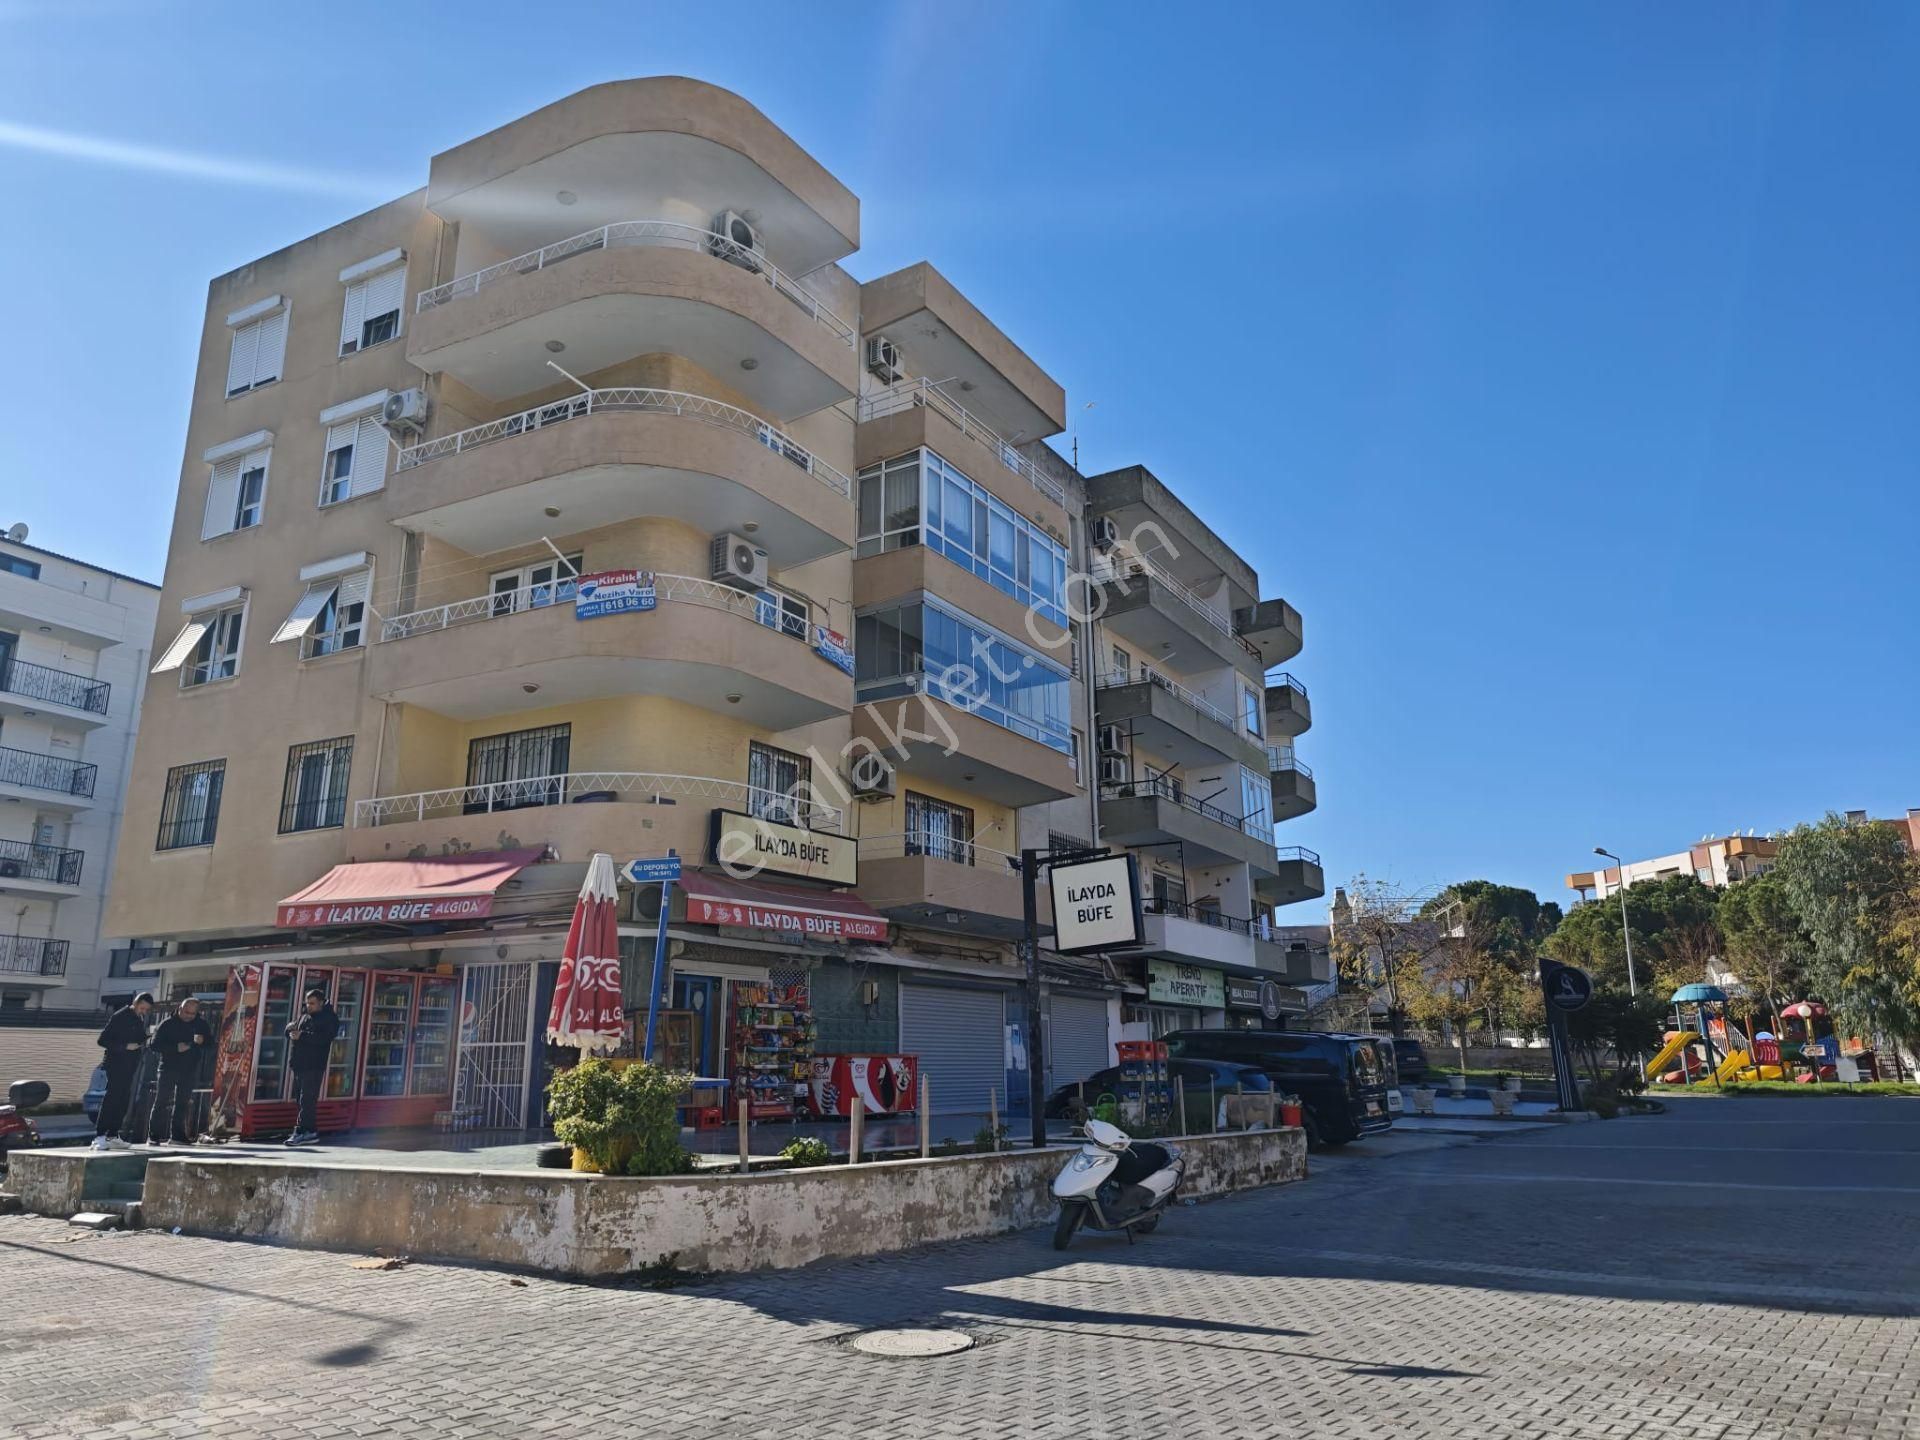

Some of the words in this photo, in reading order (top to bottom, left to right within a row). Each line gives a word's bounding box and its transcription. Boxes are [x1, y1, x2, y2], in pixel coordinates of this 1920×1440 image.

[598, 573, 636, 585] Kiralık
[605, 599, 625, 610] 618
[626, 597, 639, 606] 06
[754, 830, 798, 859] İLAYDA
[800, 841, 830, 865] BÜFE
[1067, 883, 1116, 903] İLAYDA
[327, 903, 384, 922] İLAYDA
[387, 901, 434, 920] BÜFE
[748, 907, 802, 931] İLAYDA
[805, 915, 842, 935] BÜFE
[1077, 904, 1114, 924] BÜFE
